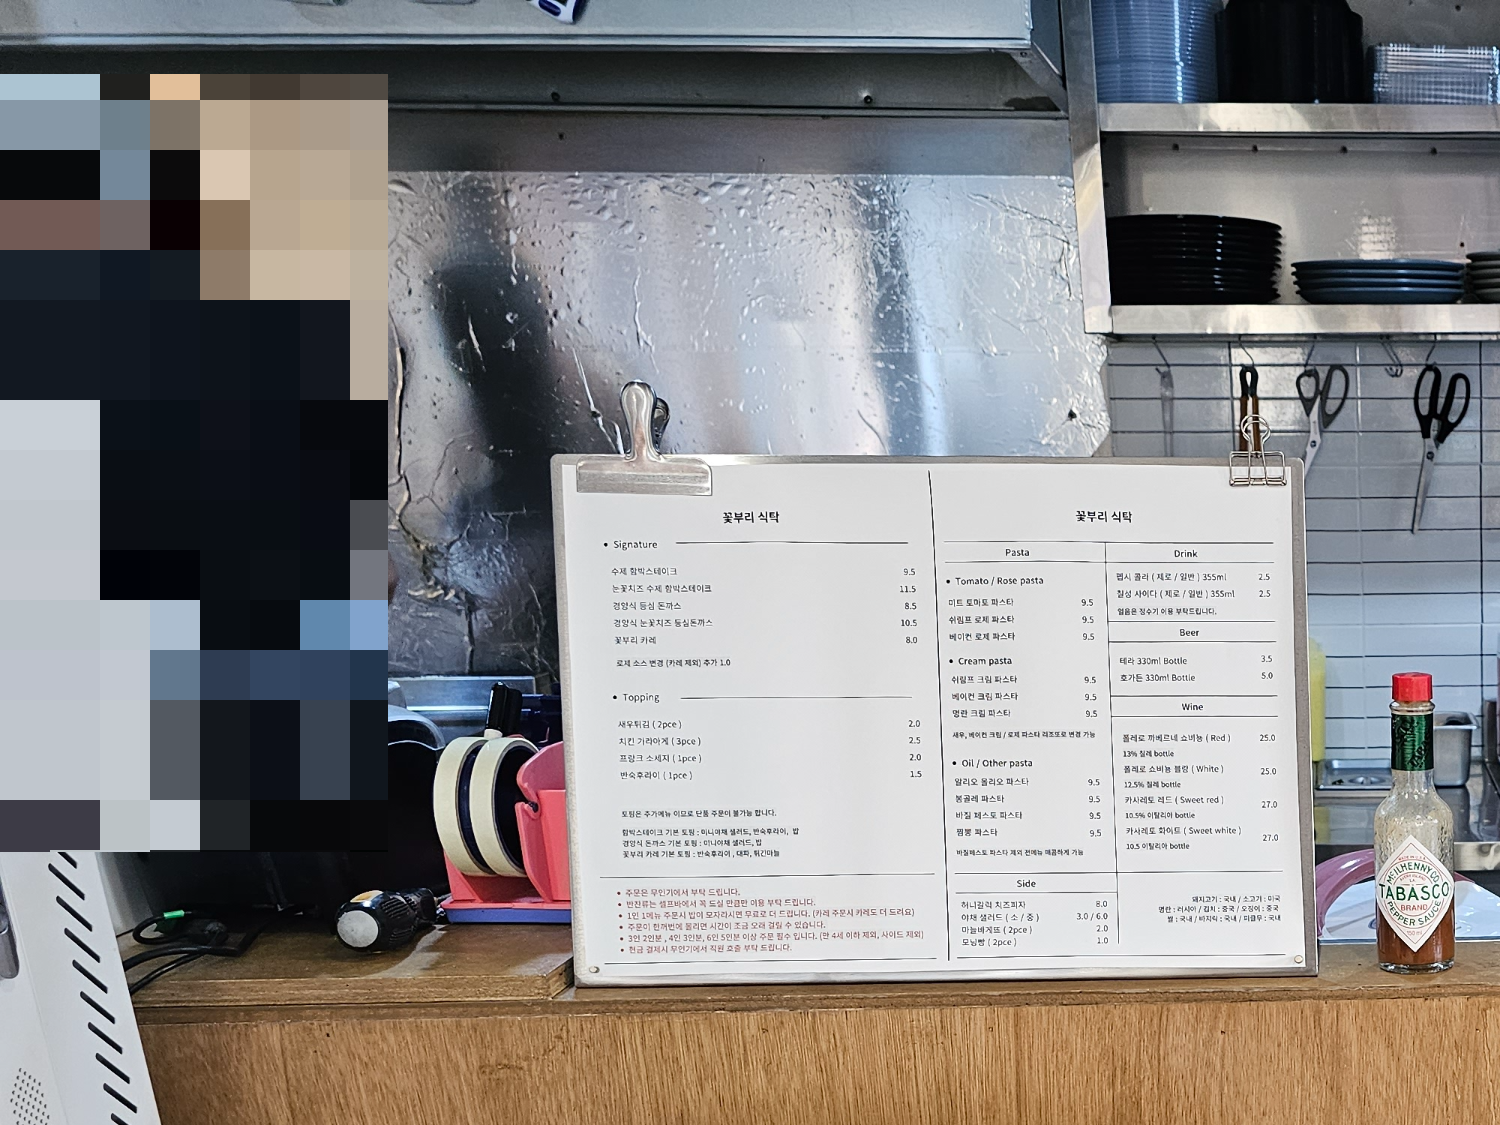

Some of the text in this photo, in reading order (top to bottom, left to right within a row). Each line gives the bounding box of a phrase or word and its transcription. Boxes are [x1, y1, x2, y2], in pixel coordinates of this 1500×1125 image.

[722, 511, 779, 524] 꽃부리 식탁
[1075, 511, 1132, 523] 꽃부리 식탁
[613, 540, 658, 551] Signature
[611, 568, 627, 576] 수제
[630, 567, 677, 575] 함박스테이크
[955, 577, 989, 585] Tomato
[1020, 577, 1044, 586] pasta
[1134, 573, 1149, 581] 콜라
[612, 585, 916, 593] 눈꽃치즈 수제 함박스테이크 11.5
[1134, 590, 1157, 598] 사이다
[613, 602, 917, 610] 경양식 등심 돈까스 8.5
[948, 599, 964, 607] 미트
[966, 599, 989, 607] 토마토
[991, 598, 1014, 606] 파스타
[614, 619, 637, 627] 경양식
[640, 619, 672, 627] 눈꽃치즈
[948, 616, 972, 624] 쉬림프
[991, 615, 1015, 623] 파스타
[615, 636, 918, 644] 꽃부리 카레 8.0
[949, 633, 972, 641] 베이컨
[975, 633, 990, 641] 로제
[992, 632, 1015, 641] 파스타
[988, 657, 1012, 667] pasta
[1119, 657, 1135, 665] 테라
[1137, 657, 1161, 665] 330ml
[1163, 657, 1187, 665] Bottle
[951, 676, 974, 684] 쉬림프
[994, 675, 1018, 683] 파스타
[1120, 674, 1143, 682] 호가든
[622, 693, 660, 703] Topping
[951, 692, 1097, 701] 베이컨 크림 파스타 9.5
[952, 709, 1098, 718] 명란 크림 파스타 9.5
[618, 720, 650, 728] 새우튀김
[619, 738, 635, 746] 치킨
[620, 754, 643, 763] 프랑크
[646, 754, 669, 762] 소세지
[961, 759, 1033, 769] Oil Other pasta
[620, 771, 660, 779] 반숙후라이
[954, 778, 978, 786] 알리오
[981, 778, 1004, 786] 올리오
[1006, 778, 1029, 786] 파스타
[955, 795, 1101, 803] 봉골레 파스타 9.5
[955, 811, 971, 819] 바질
[1000, 811, 1022, 819] 파스타
[974, 828, 998, 836] 파스타
[1089, 829, 1102, 837] 9.5
[1017, 880, 1037, 888] Side
[1379, 881, 1450, 901] TABASCO
[995, 901, 1026, 909] 치즈피자
[1401, 904, 1428, 912] BRAND
[961, 914, 977, 922] 야채
[979, 913, 1002, 922] 샐러드
[1387, 901, 1441, 926] PEPPER SAUCE
[962, 938, 985, 946] 모닝빵
